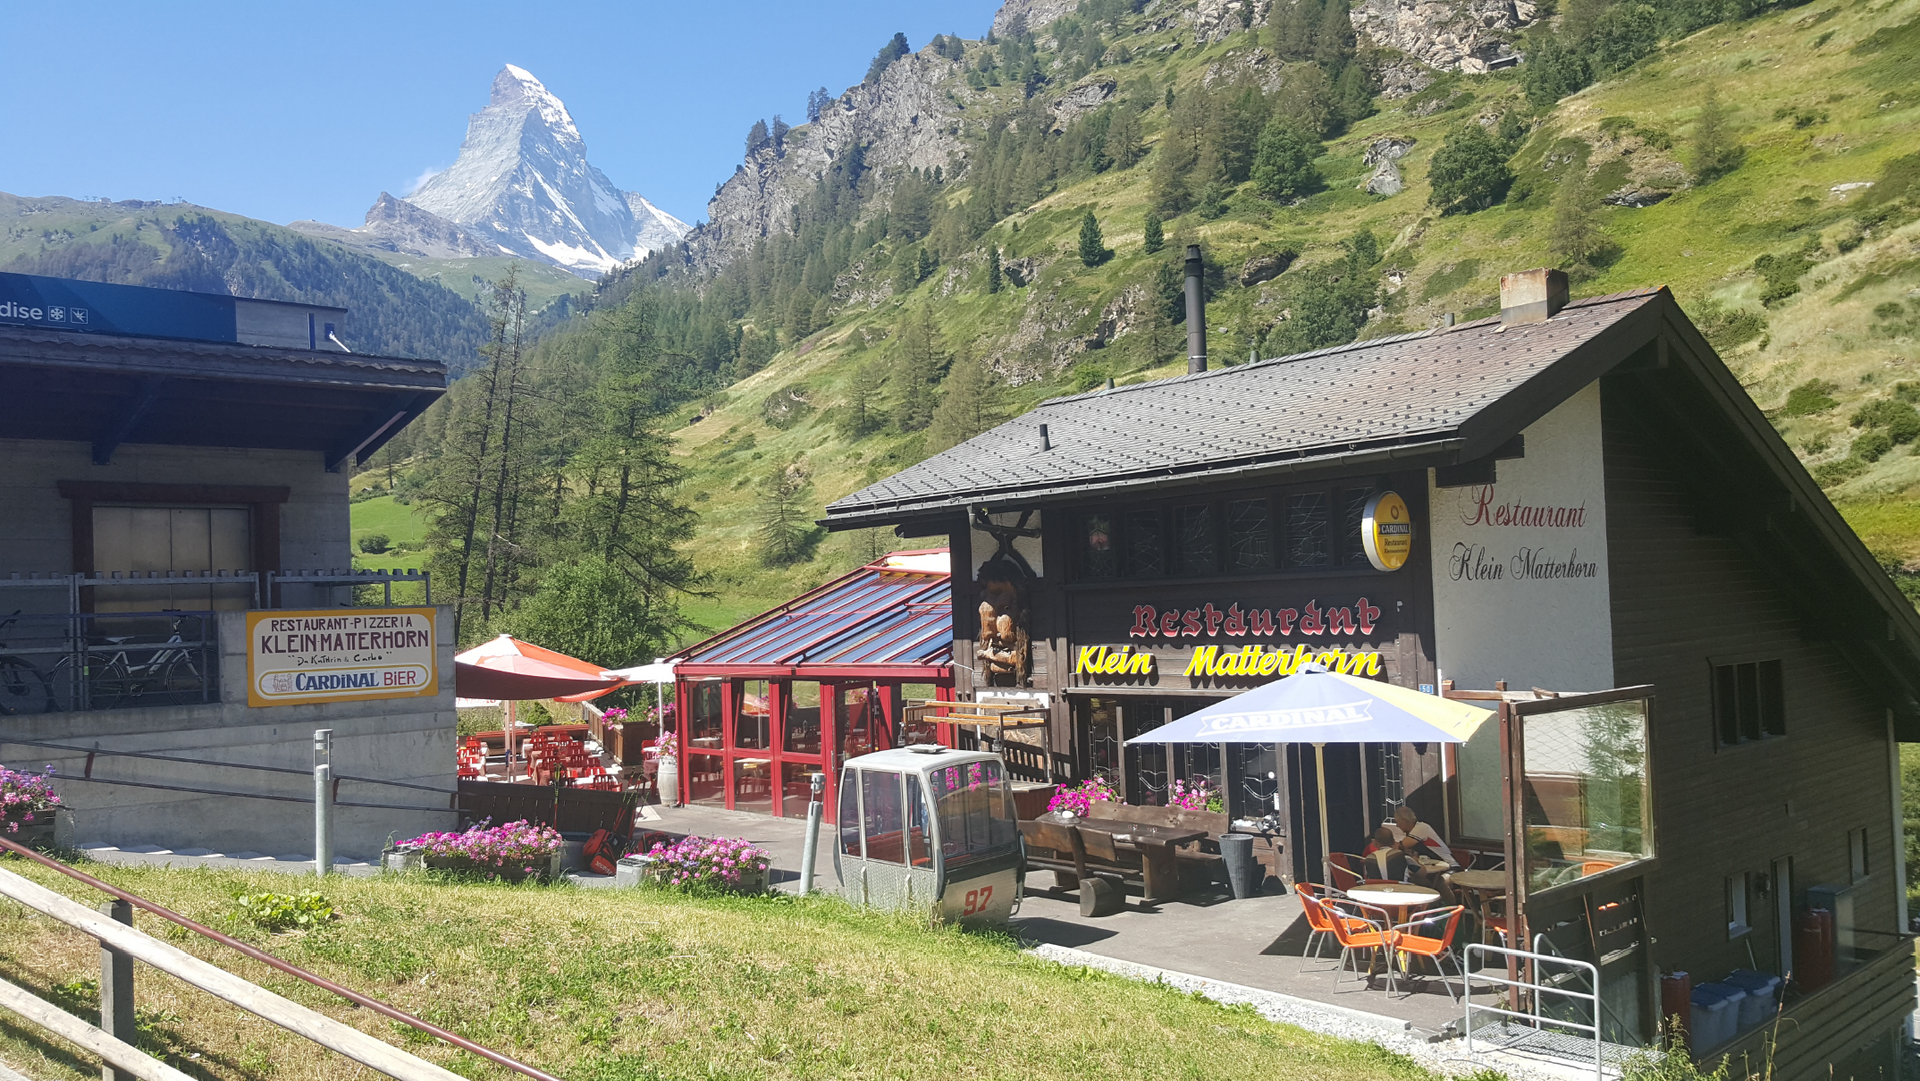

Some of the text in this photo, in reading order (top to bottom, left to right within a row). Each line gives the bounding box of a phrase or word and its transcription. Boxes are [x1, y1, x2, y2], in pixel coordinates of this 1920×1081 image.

[1458, 484, 1588, 528] Restaurant
[1381, 524, 1409, 534] CARDINAL
[1449, 541, 1599, 582] Klein Matterhorn
[1129, 597, 1381, 638] Restaurant
[1075, 644, 1381, 676] Klein Matterhorn
[1211, 706, 1364, 730] CARDINAL
[963, 885, 993, 916] 97
